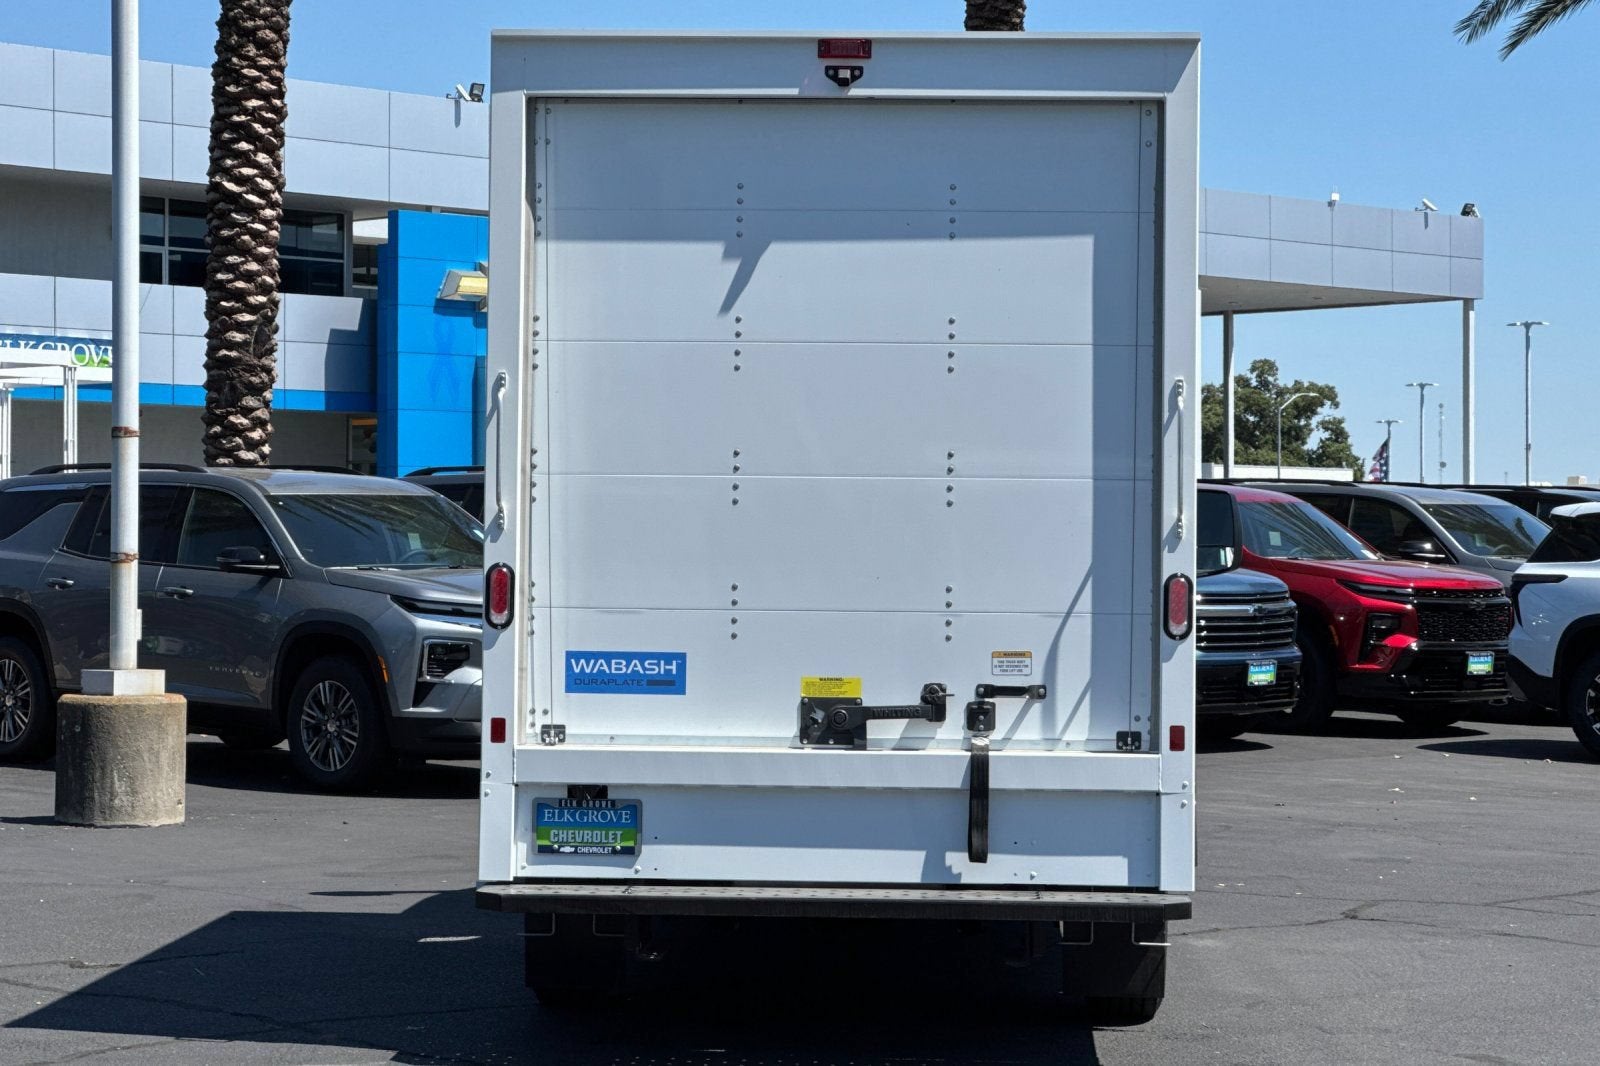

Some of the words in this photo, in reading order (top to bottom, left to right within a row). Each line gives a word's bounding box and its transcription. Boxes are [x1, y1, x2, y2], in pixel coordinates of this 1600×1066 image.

[570, 658, 677, 675] WABASH
[573, 678, 644, 687] DURAPLATE
[550, 829, 623, 844] CHEVROLET
[577, 846, 613, 854] CHEVROLET
